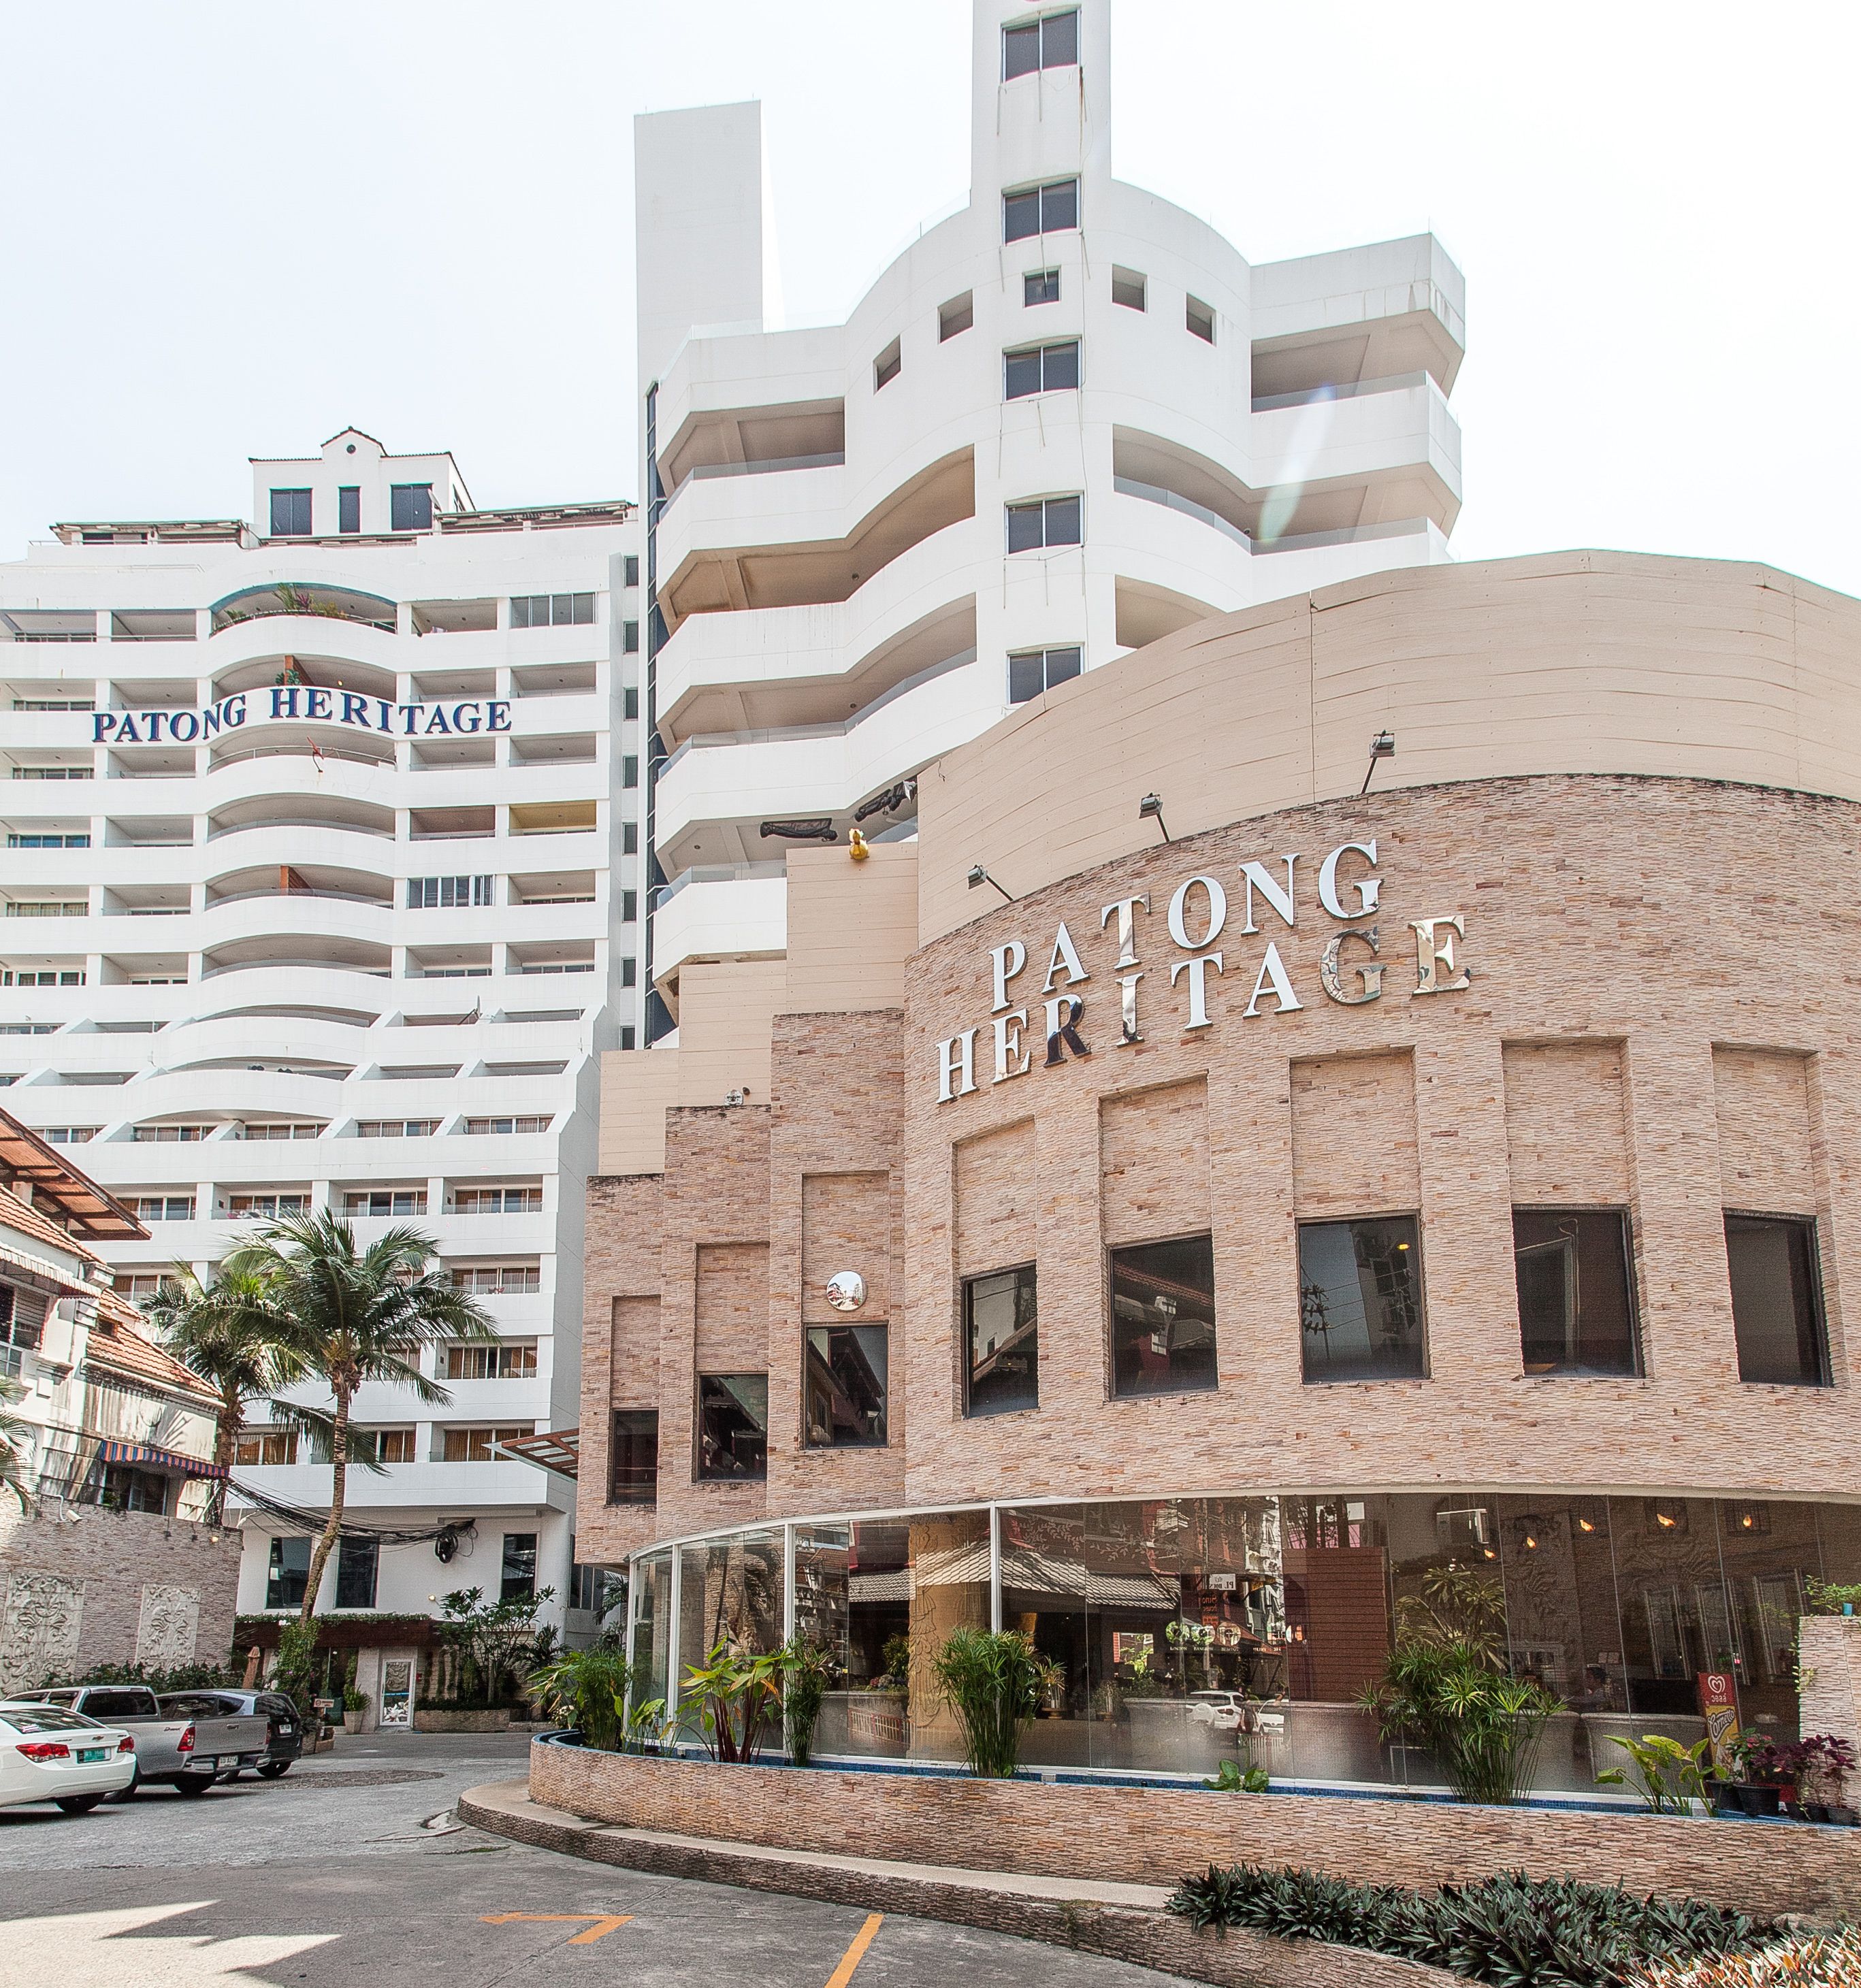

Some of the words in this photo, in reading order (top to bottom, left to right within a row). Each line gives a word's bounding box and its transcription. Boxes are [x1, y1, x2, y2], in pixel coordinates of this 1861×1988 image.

[91, 694, 247, 743] PATONG
[269, 687, 513, 735] HERITAGE
[988, 838, 1384, 1014] PATONG
[935, 914, 1472, 1105] HERITAGE
[1707, 1708, 1735, 1743] Cornetto
